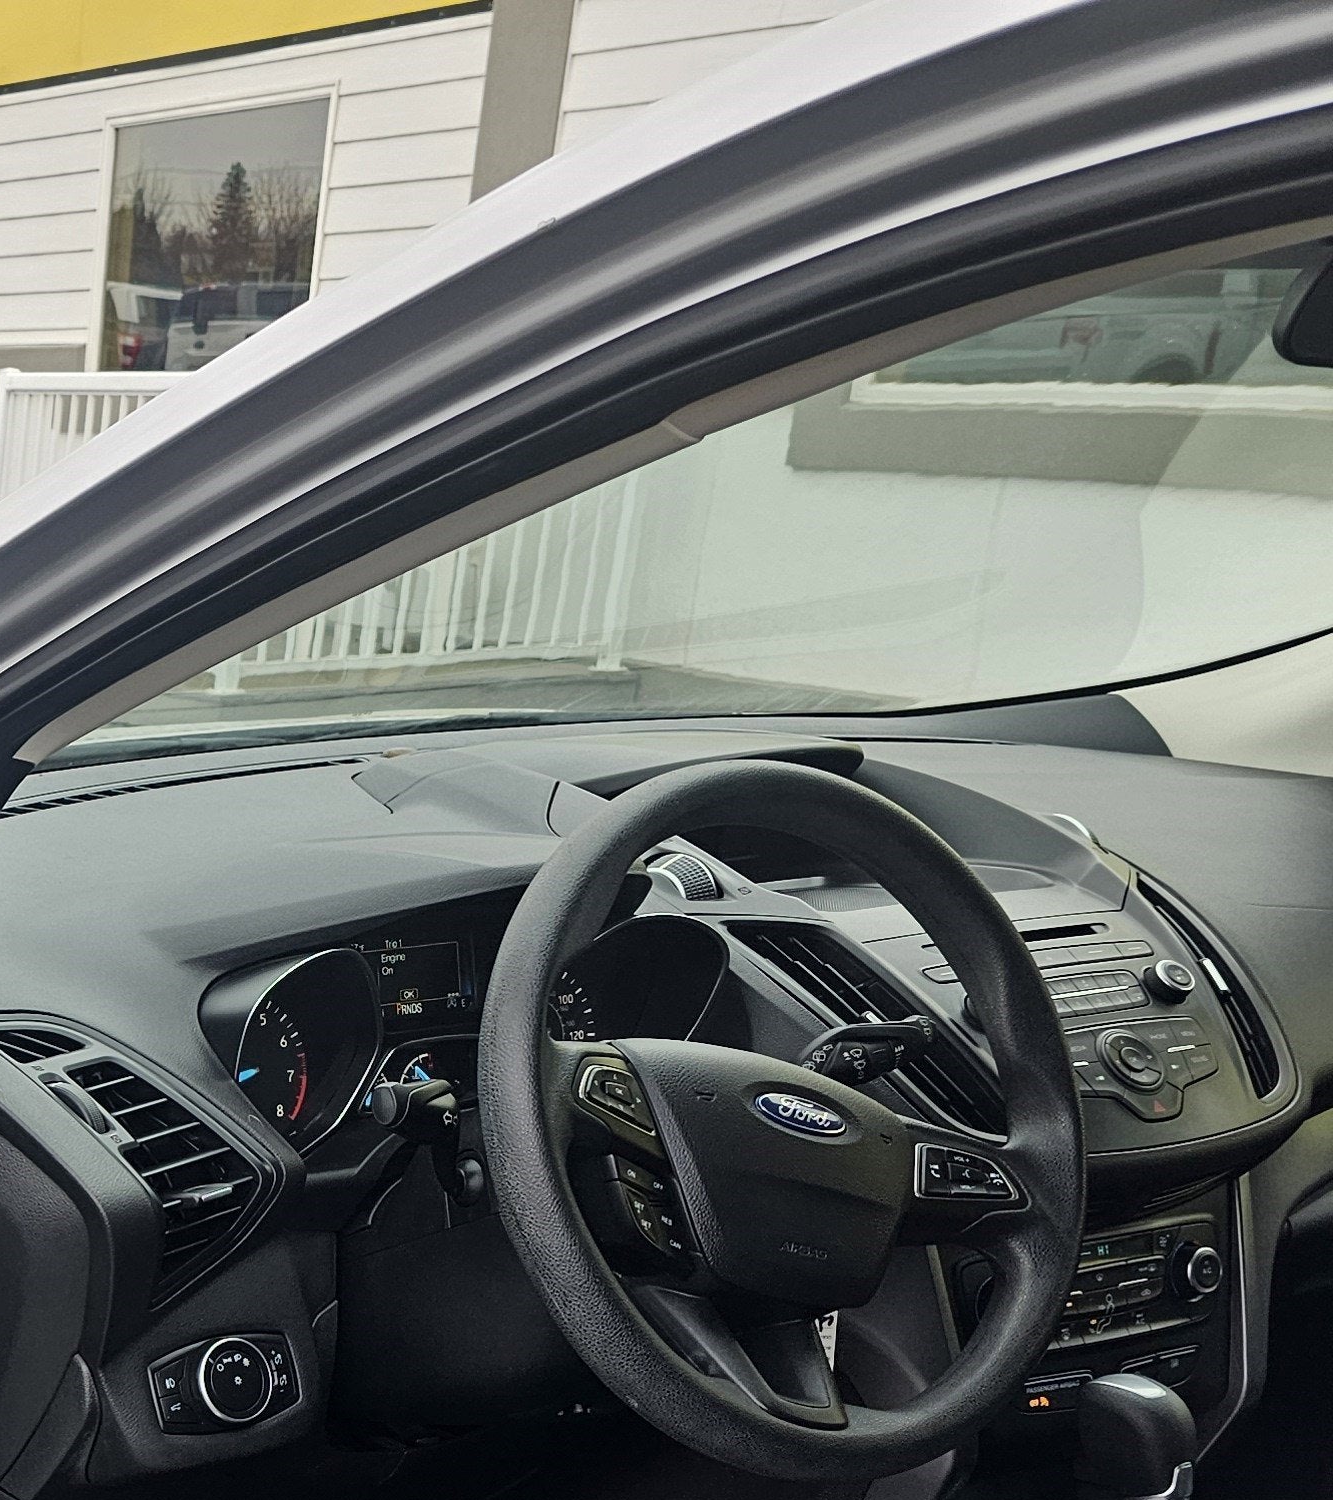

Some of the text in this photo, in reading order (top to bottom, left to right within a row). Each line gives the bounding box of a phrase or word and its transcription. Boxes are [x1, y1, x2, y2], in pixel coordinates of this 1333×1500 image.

[380, 953, 406, 964] Engine
[381, 966, 394, 976] On
[403, 990, 415, 999] OK
[558, 993, 574, 1005] 100
[259, 1012, 268, 1026] 5
[279, 1034, 288, 1048] 6
[569, 1029, 585, 1041] 120
[286, 1069, 295, 1083] 7
[276, 1104, 284, 1117] 8
[777, 1095, 831, 1129] Ford
